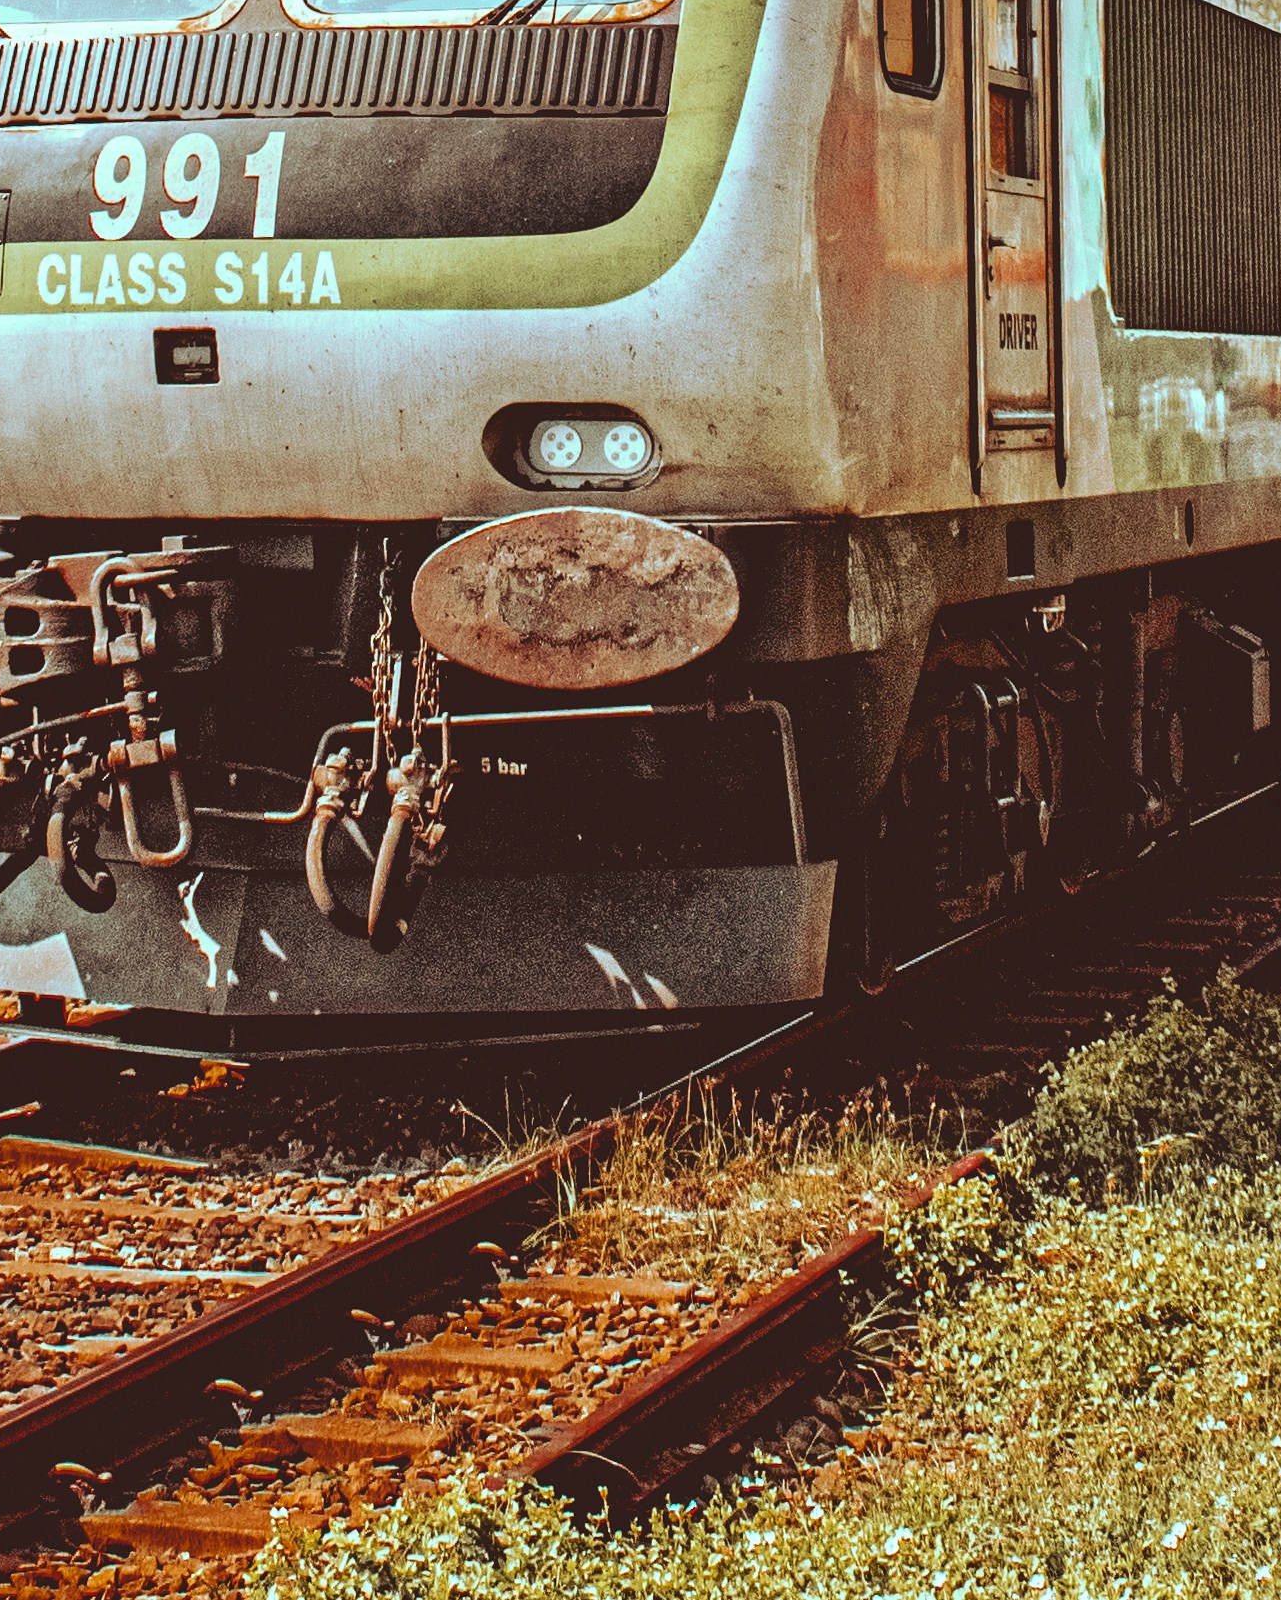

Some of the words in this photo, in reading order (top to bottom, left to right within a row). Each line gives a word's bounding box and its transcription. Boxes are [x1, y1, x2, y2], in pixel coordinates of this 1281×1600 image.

[89, 130, 286, 240] 991
[36, 252, 187, 306] CLASS
[214, 251, 342, 304] S14A
[999, 312, 1038, 350] DRIVER
[481, 757, 491, 774] 5
[497, 757, 528, 776] bar
